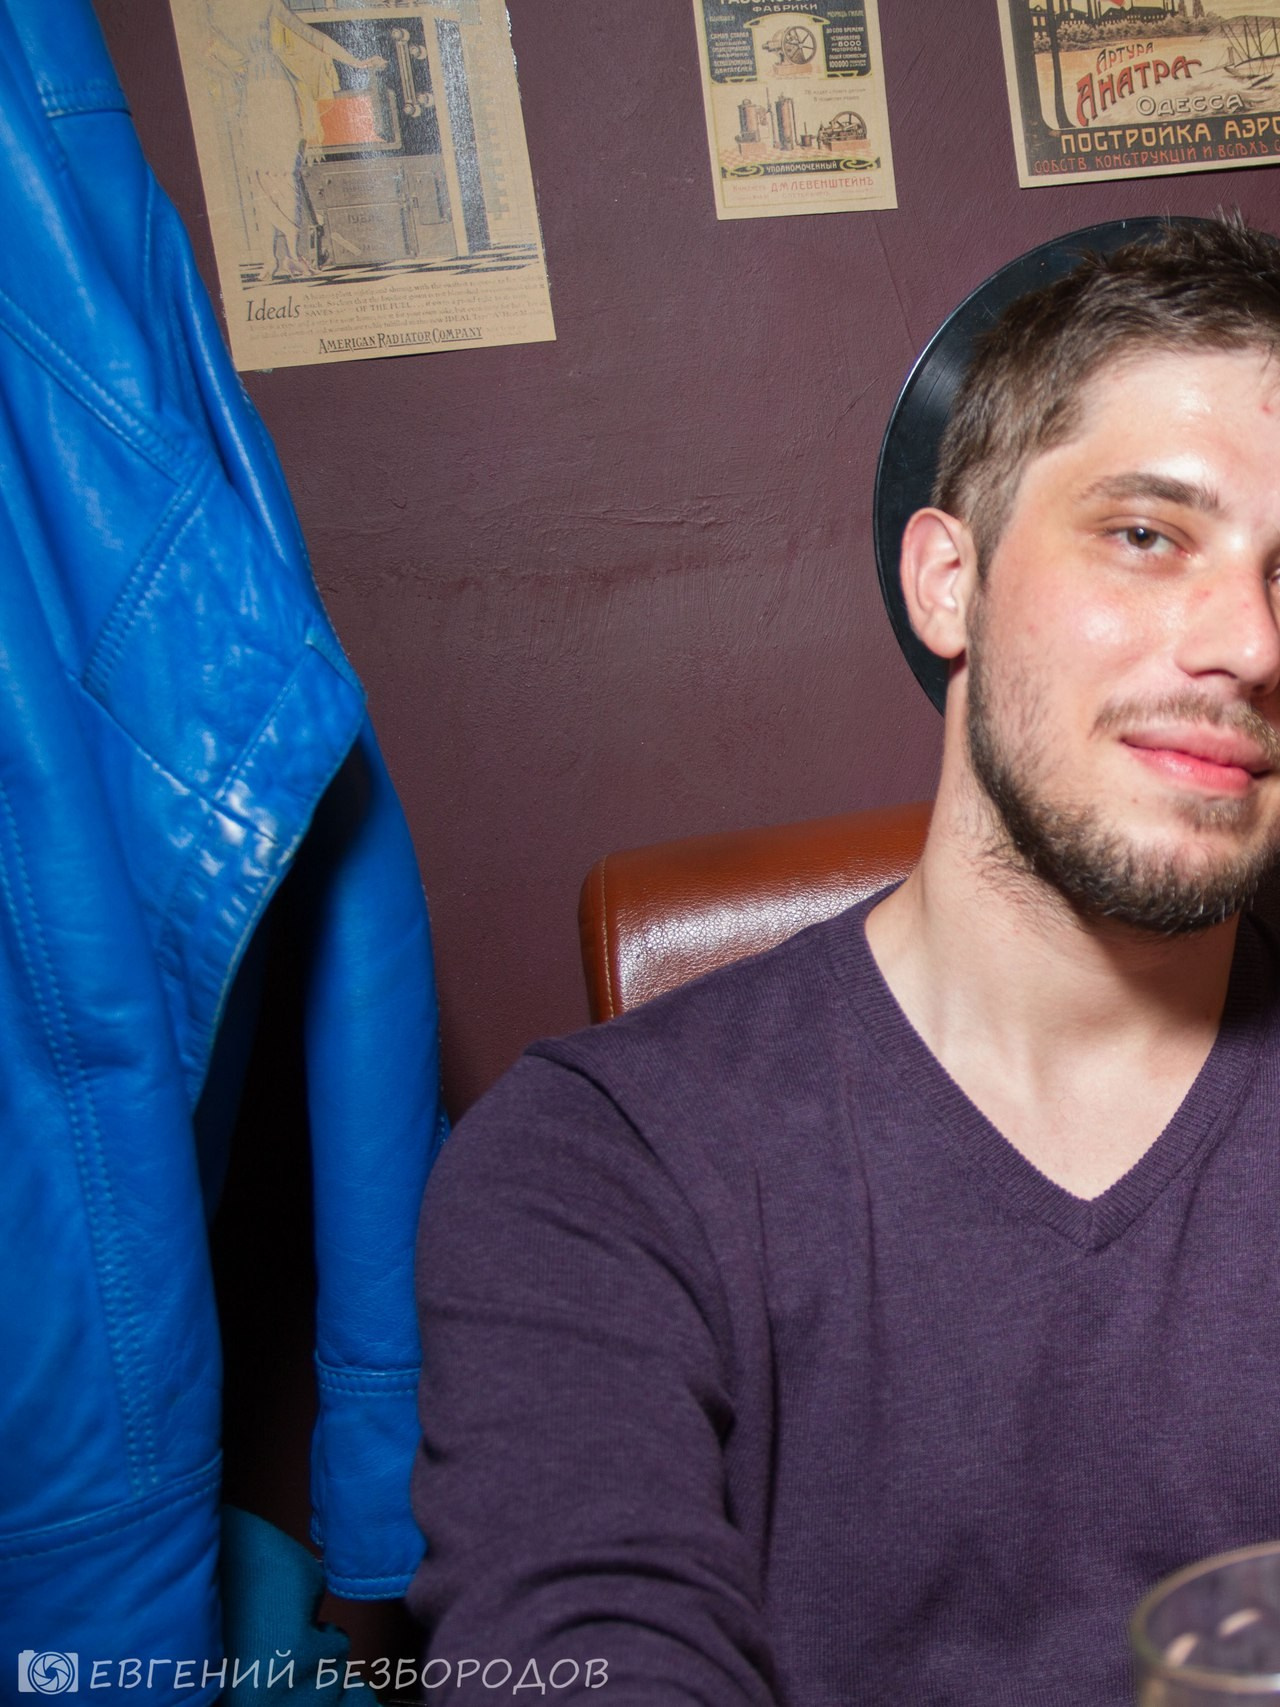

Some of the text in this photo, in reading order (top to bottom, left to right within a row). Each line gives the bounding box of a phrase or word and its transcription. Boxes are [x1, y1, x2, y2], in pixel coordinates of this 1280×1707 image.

[752, 4, 818, 12] ФАБРИКИ
[1096, 42, 1154, 75] АРТУРА
[1076, 55, 1202, 127] АНАТРА
[1136, 94, 1244, 116] ОДЕССА
[1061, 122, 1212, 154] ПОСТРОЙКА
[1203, 144, 1213, 157] И
[766, 161, 838, 173] УПОЛНОМОЧЕННЫЙ
[245, 296, 300, 322] Ideals
[355, 305, 367, 313] OF
[370, 304, 389, 312] THE
[445, 313, 472, 323] IDEAL
[319, 335, 377, 354] AMERICAN
[377, 331, 433, 349] RADIATOR
[432, 326, 483, 344] COMPANY
